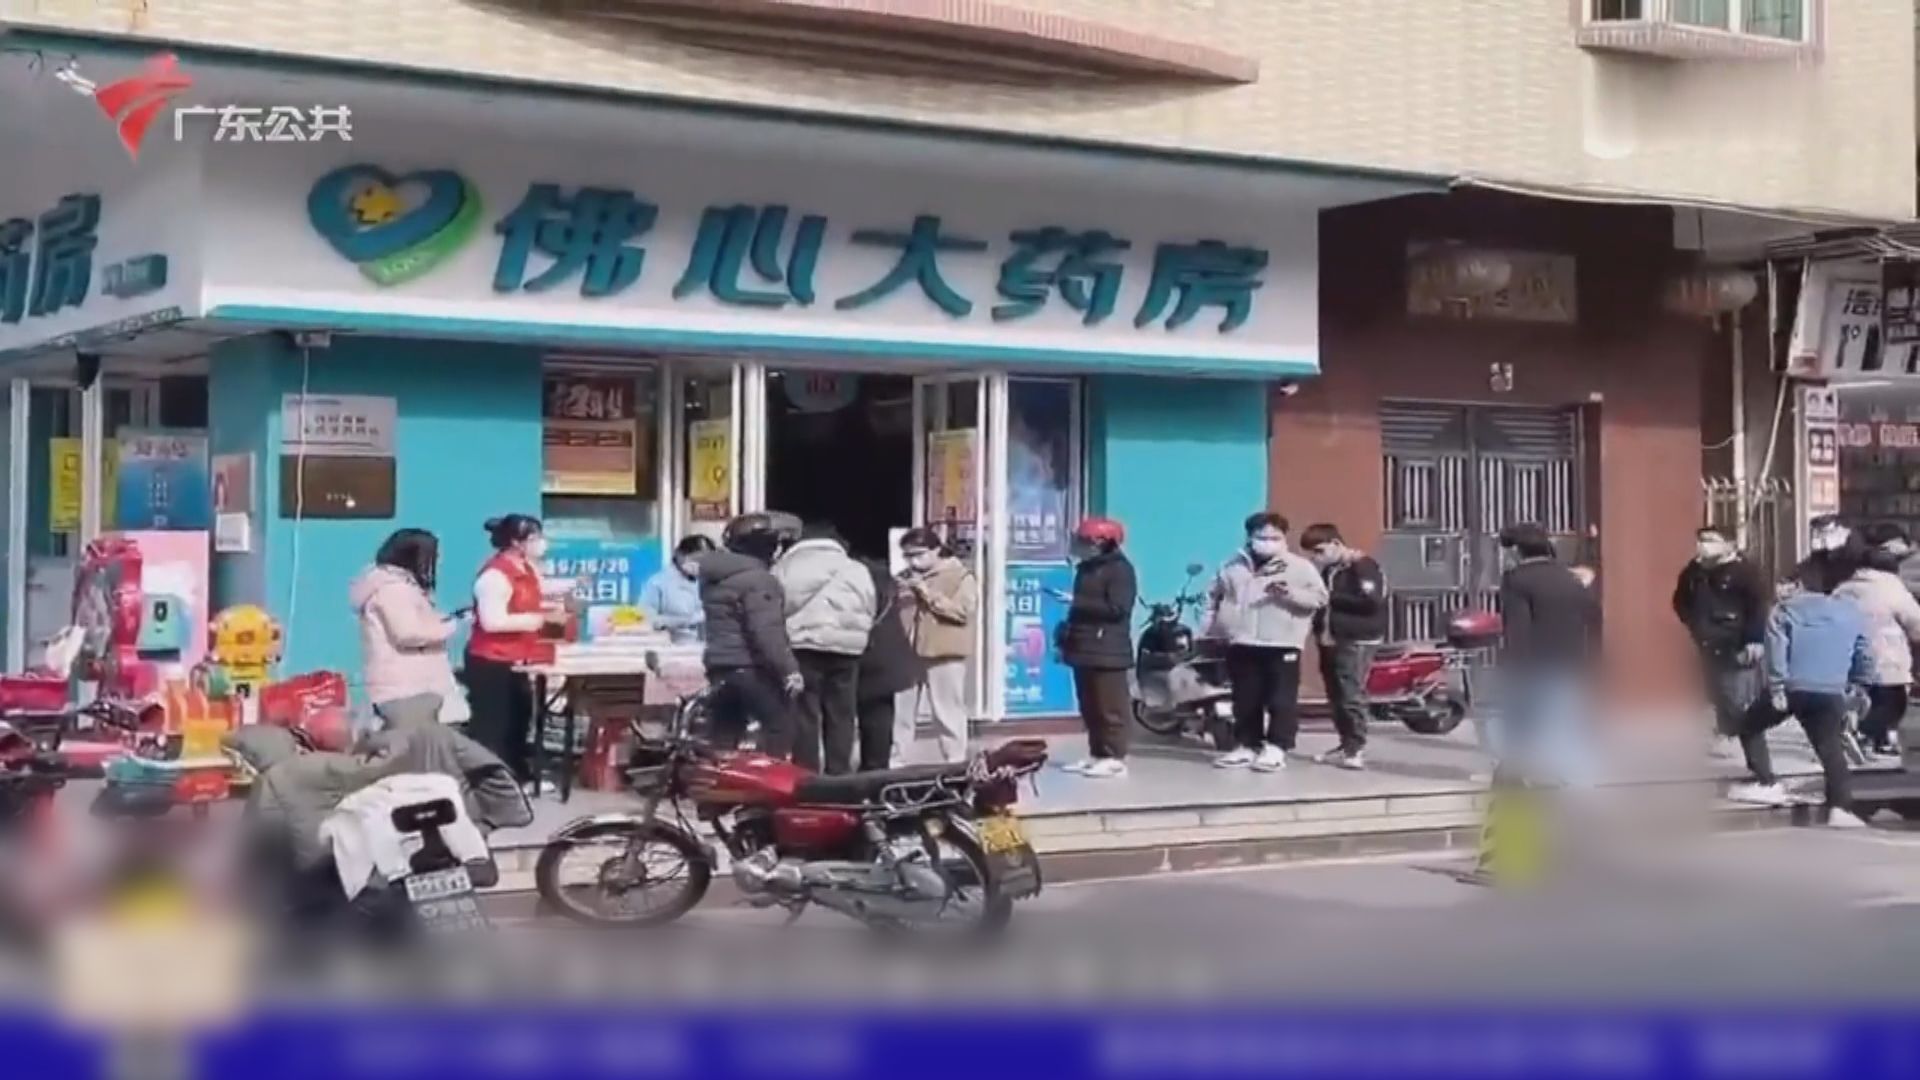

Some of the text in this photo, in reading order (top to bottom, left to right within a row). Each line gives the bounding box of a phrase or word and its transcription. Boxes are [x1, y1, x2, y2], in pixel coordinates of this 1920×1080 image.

[493, 183, 1268, 332] 佛心大药房
